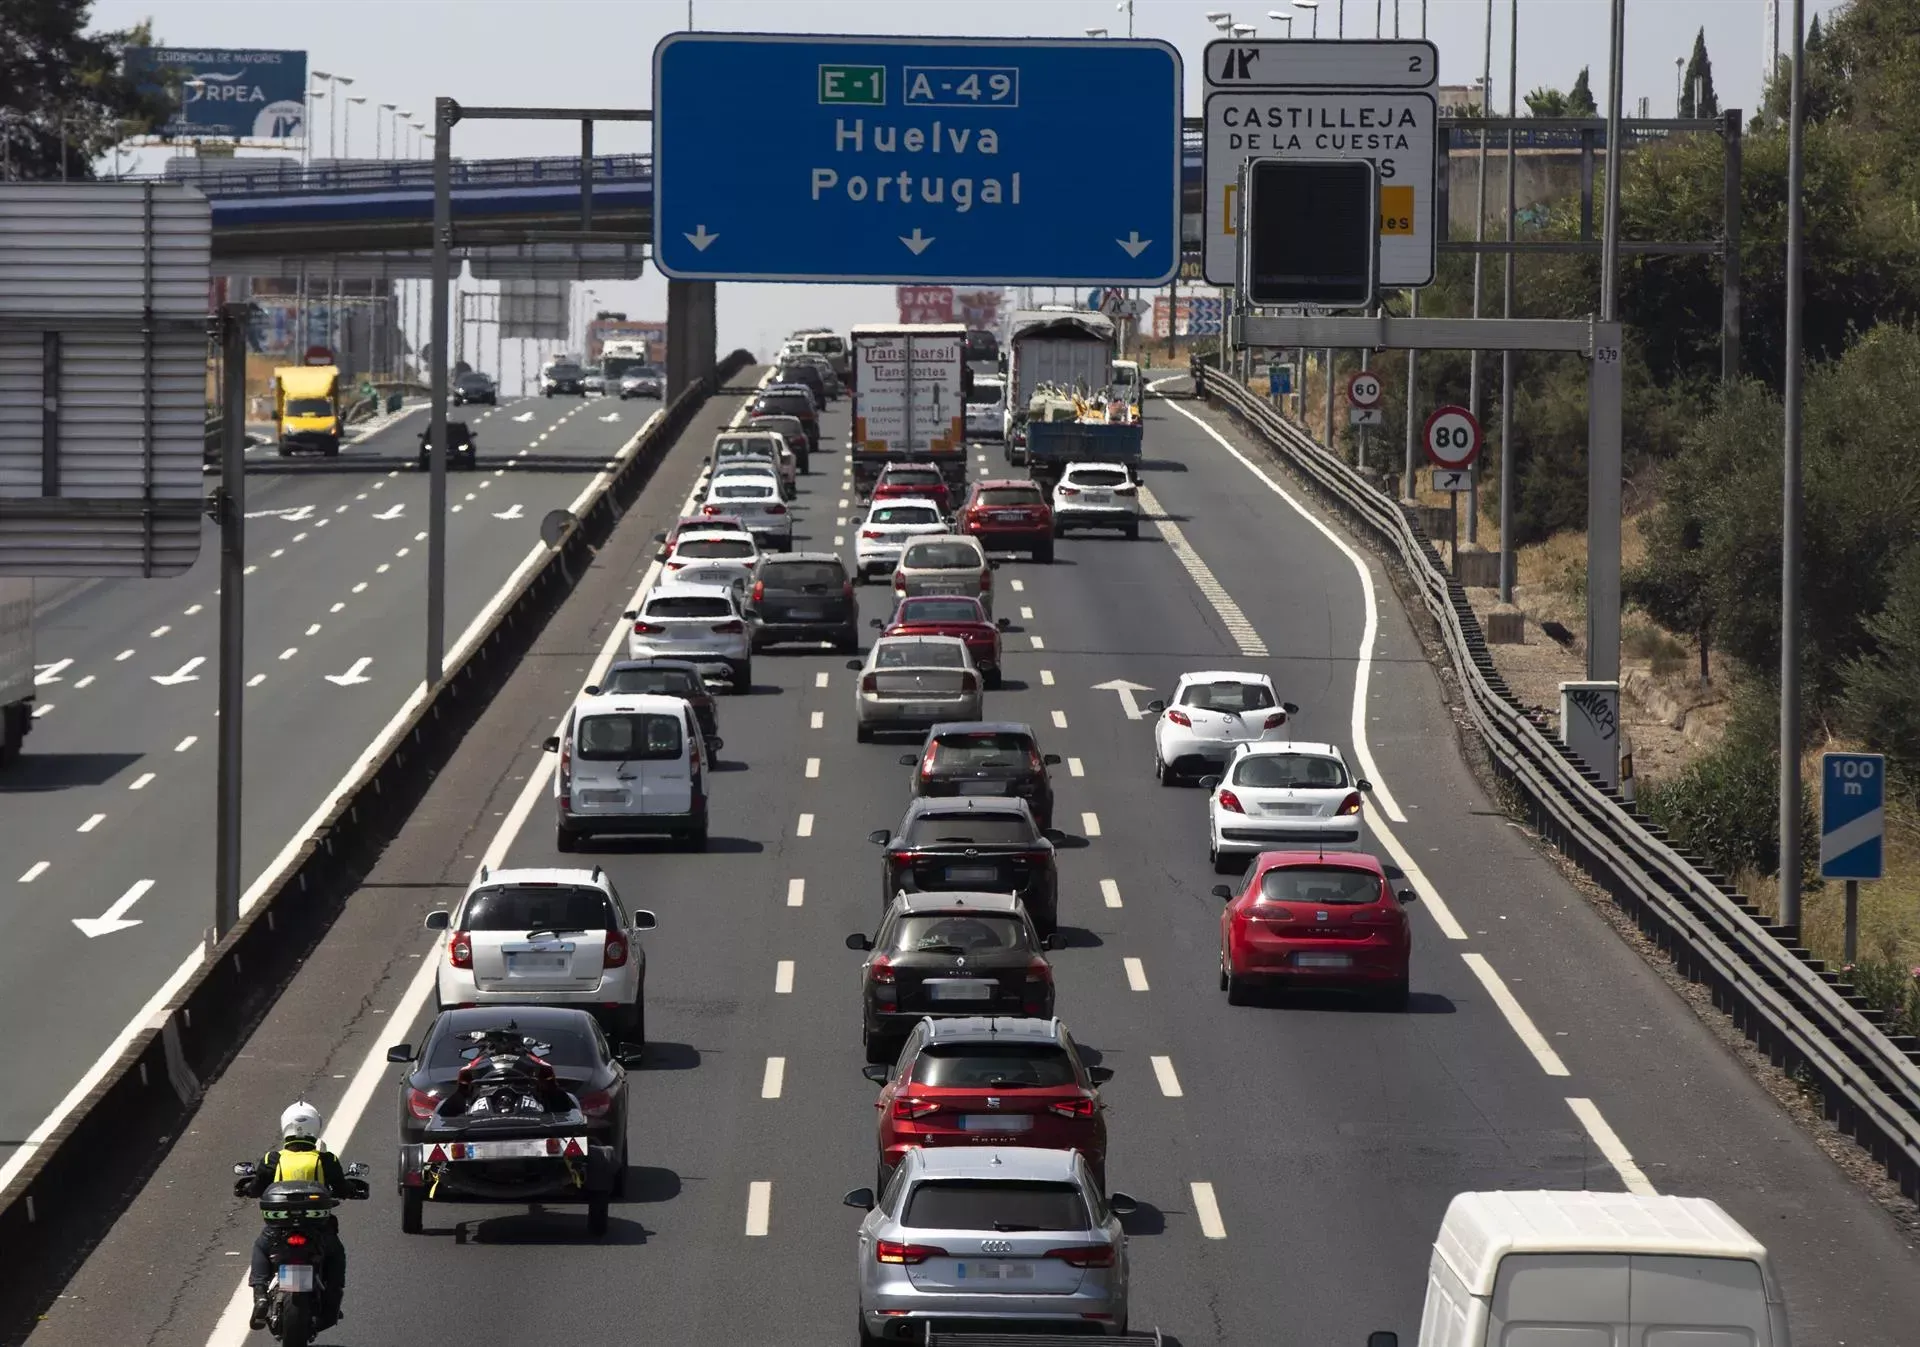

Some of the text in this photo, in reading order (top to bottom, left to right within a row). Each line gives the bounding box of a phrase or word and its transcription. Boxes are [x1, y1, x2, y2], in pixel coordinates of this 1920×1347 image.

[156, 51, 213, 64] ESIDENCIA
[1408, 55, 1422, 72] 2
[825, 71, 1011, 101] E-1 A-49
[1223, 106, 1417, 129] CASTILLEJA
[836, 118, 999, 154] Huelva
[1230, 133, 1409, 150] DE LA CUESTA
[812, 168, 1020, 213] Portugal
[1355, 383, 1377, 396] 60
[1435, 426, 1468, 448] 80
[1832, 760, 1874, 778] 100
[1844, 782, 1862, 795] m
